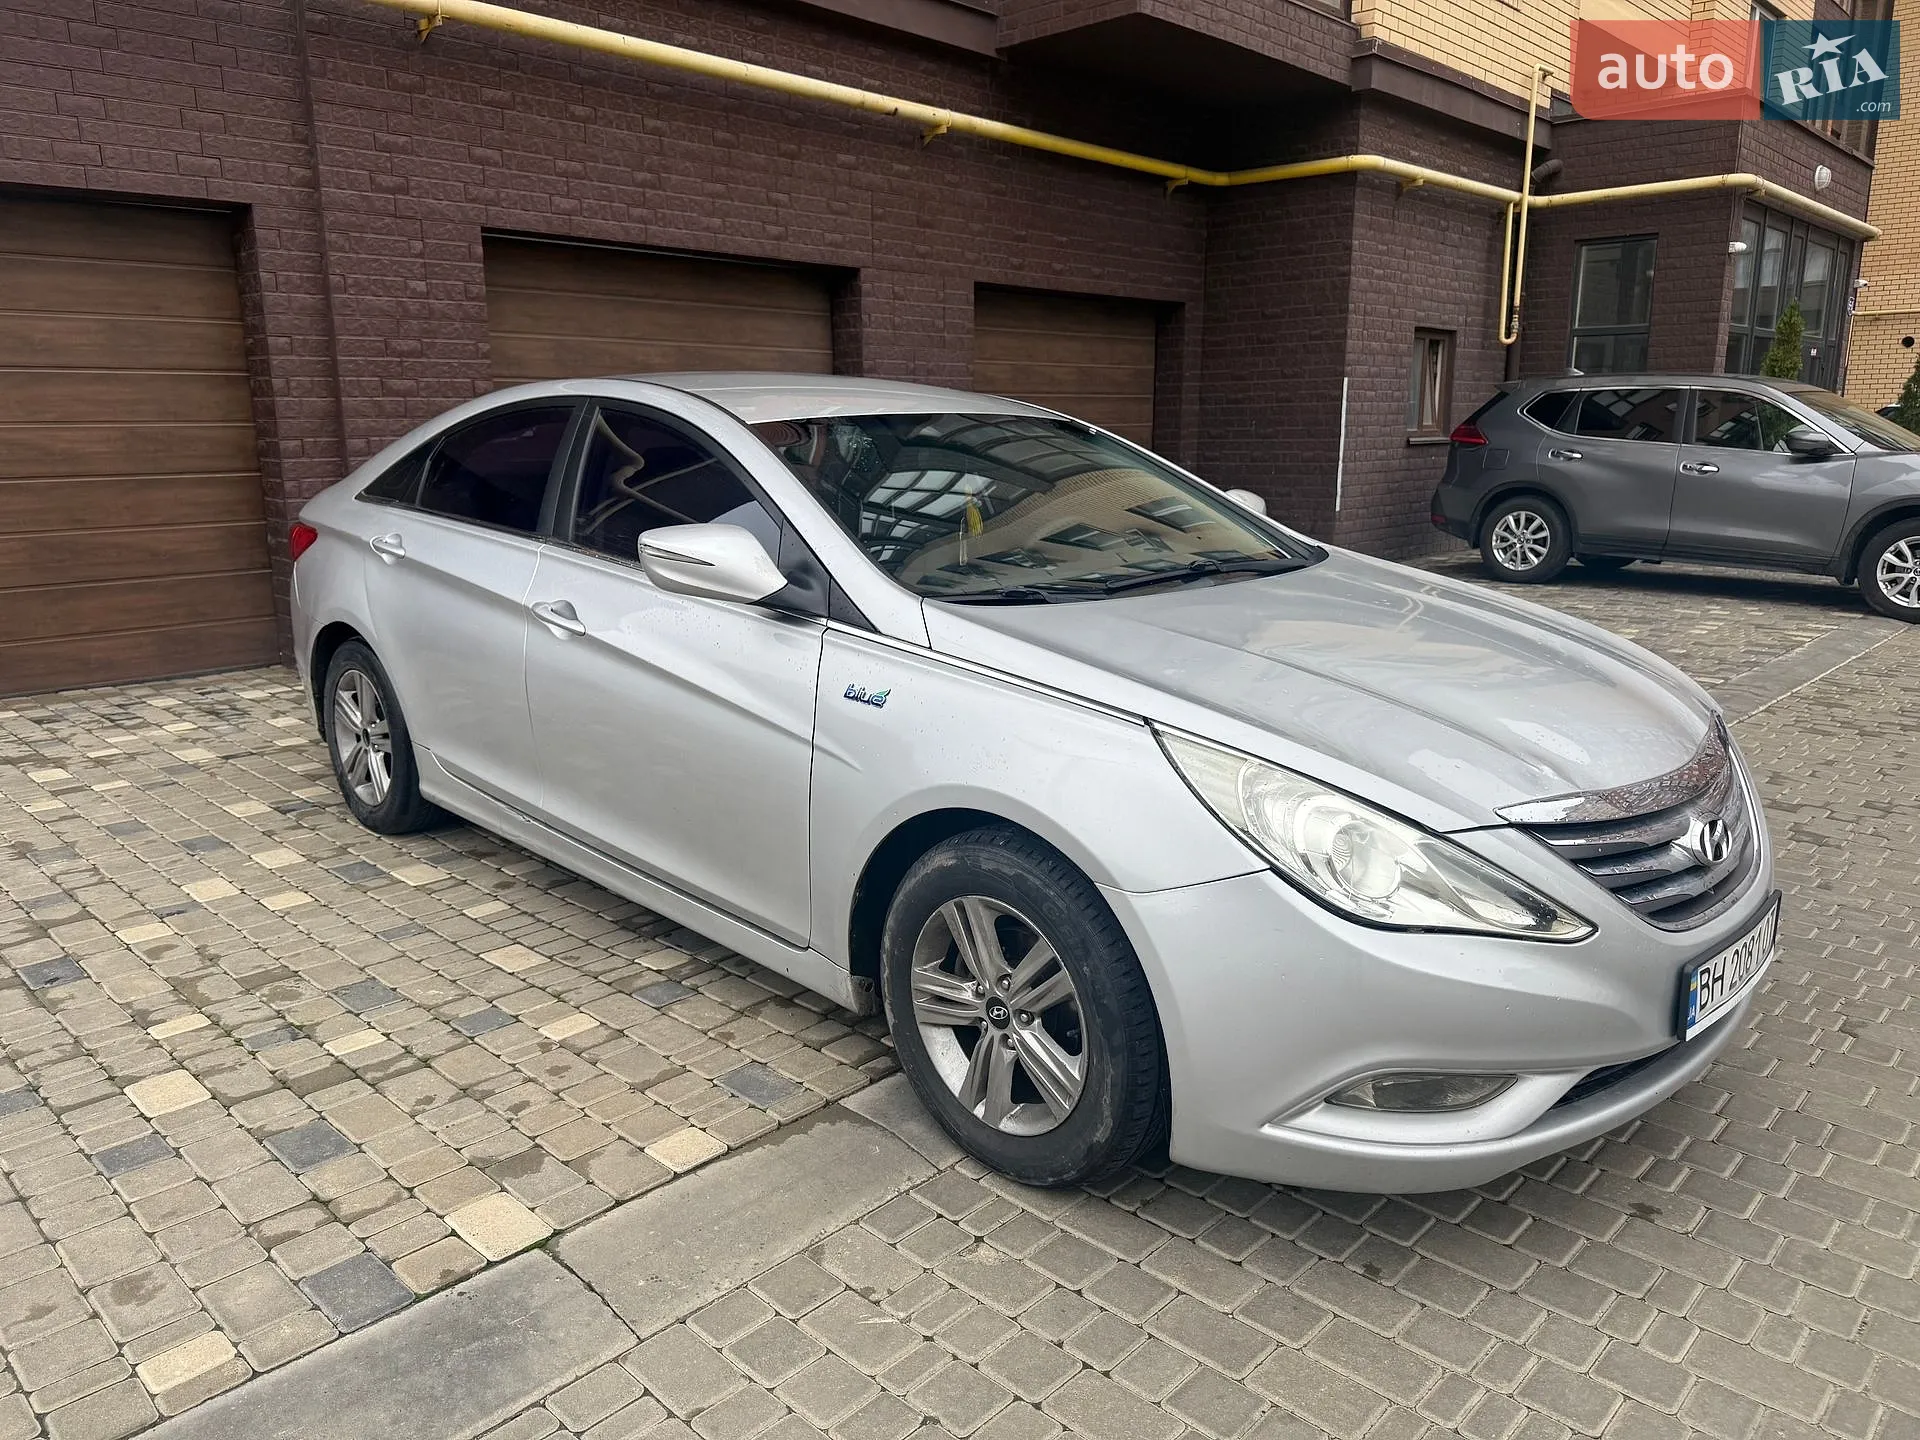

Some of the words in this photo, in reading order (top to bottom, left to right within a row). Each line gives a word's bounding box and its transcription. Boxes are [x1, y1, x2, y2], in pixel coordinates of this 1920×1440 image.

[843, 683, 891, 709] blue
[1699, 956, 1727, 1012] BH
[1728, 925, 1762, 992] 2081
